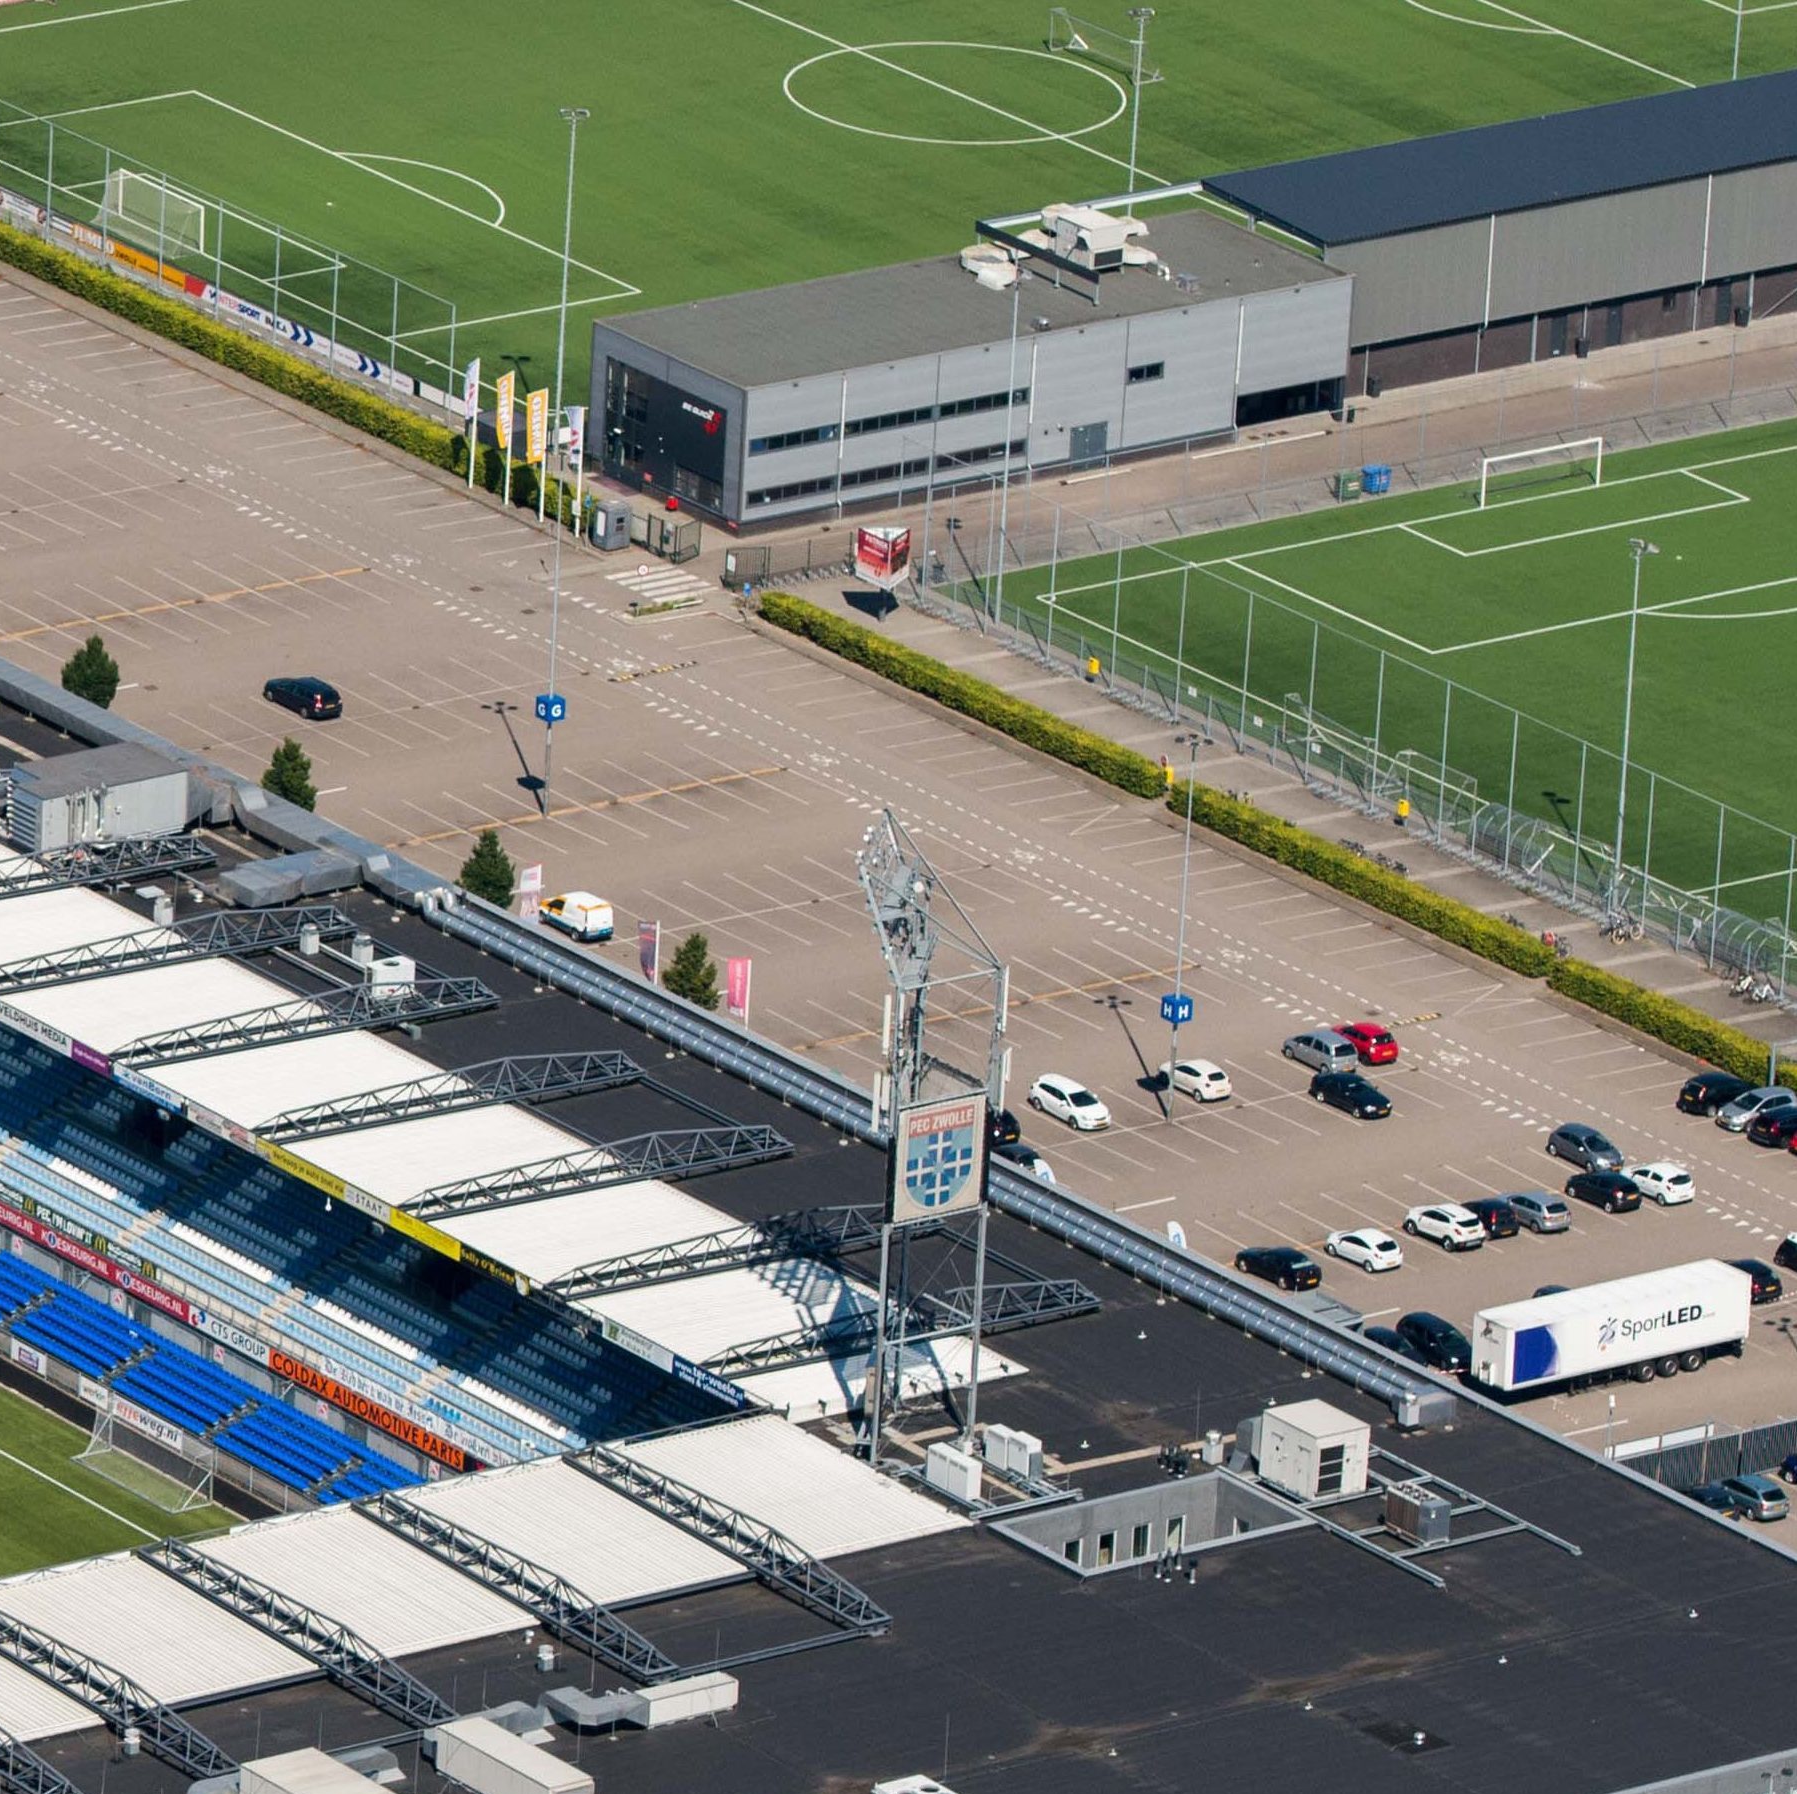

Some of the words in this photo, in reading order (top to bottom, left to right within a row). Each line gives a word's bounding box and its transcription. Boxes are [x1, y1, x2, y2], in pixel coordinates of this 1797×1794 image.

[216, 291, 261, 321] NTERSPORT
[40, 1024, 67, 1048] MEDIA
[910, 1117, 930, 1134] PEC
[931, 1109, 974, 1129] ZWOLLE
[211, 1320, 230, 1341] CTS
[230, 1328, 267, 1357] GROUP
[1621, 1304, 1703, 1341] SportLED
[271, 1353, 328, 1395] COLDAX
[332, 1380, 420, 1438] AUTOMOTIVE
[422, 1424, 465, 1463] PARTS
